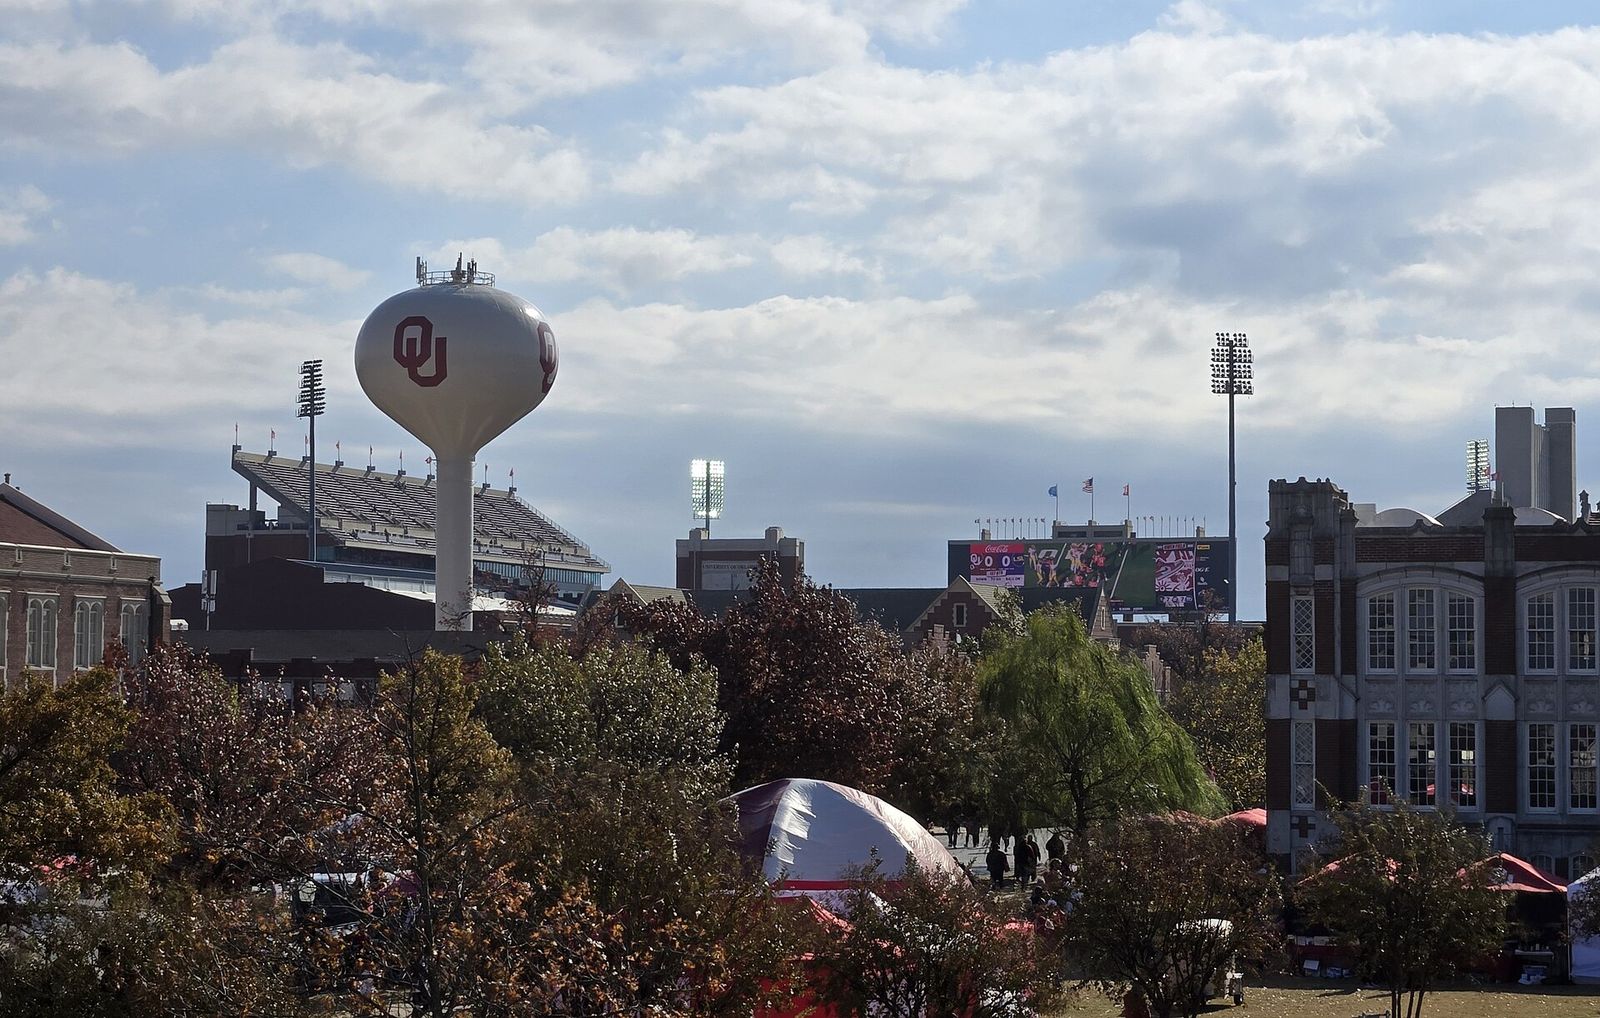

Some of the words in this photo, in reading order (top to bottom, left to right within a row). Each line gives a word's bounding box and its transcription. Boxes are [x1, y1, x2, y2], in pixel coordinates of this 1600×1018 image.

[393, 316, 448, 387] OU
[984, 555, 993, 567] 0
[1002, 555, 1011, 567] 0
